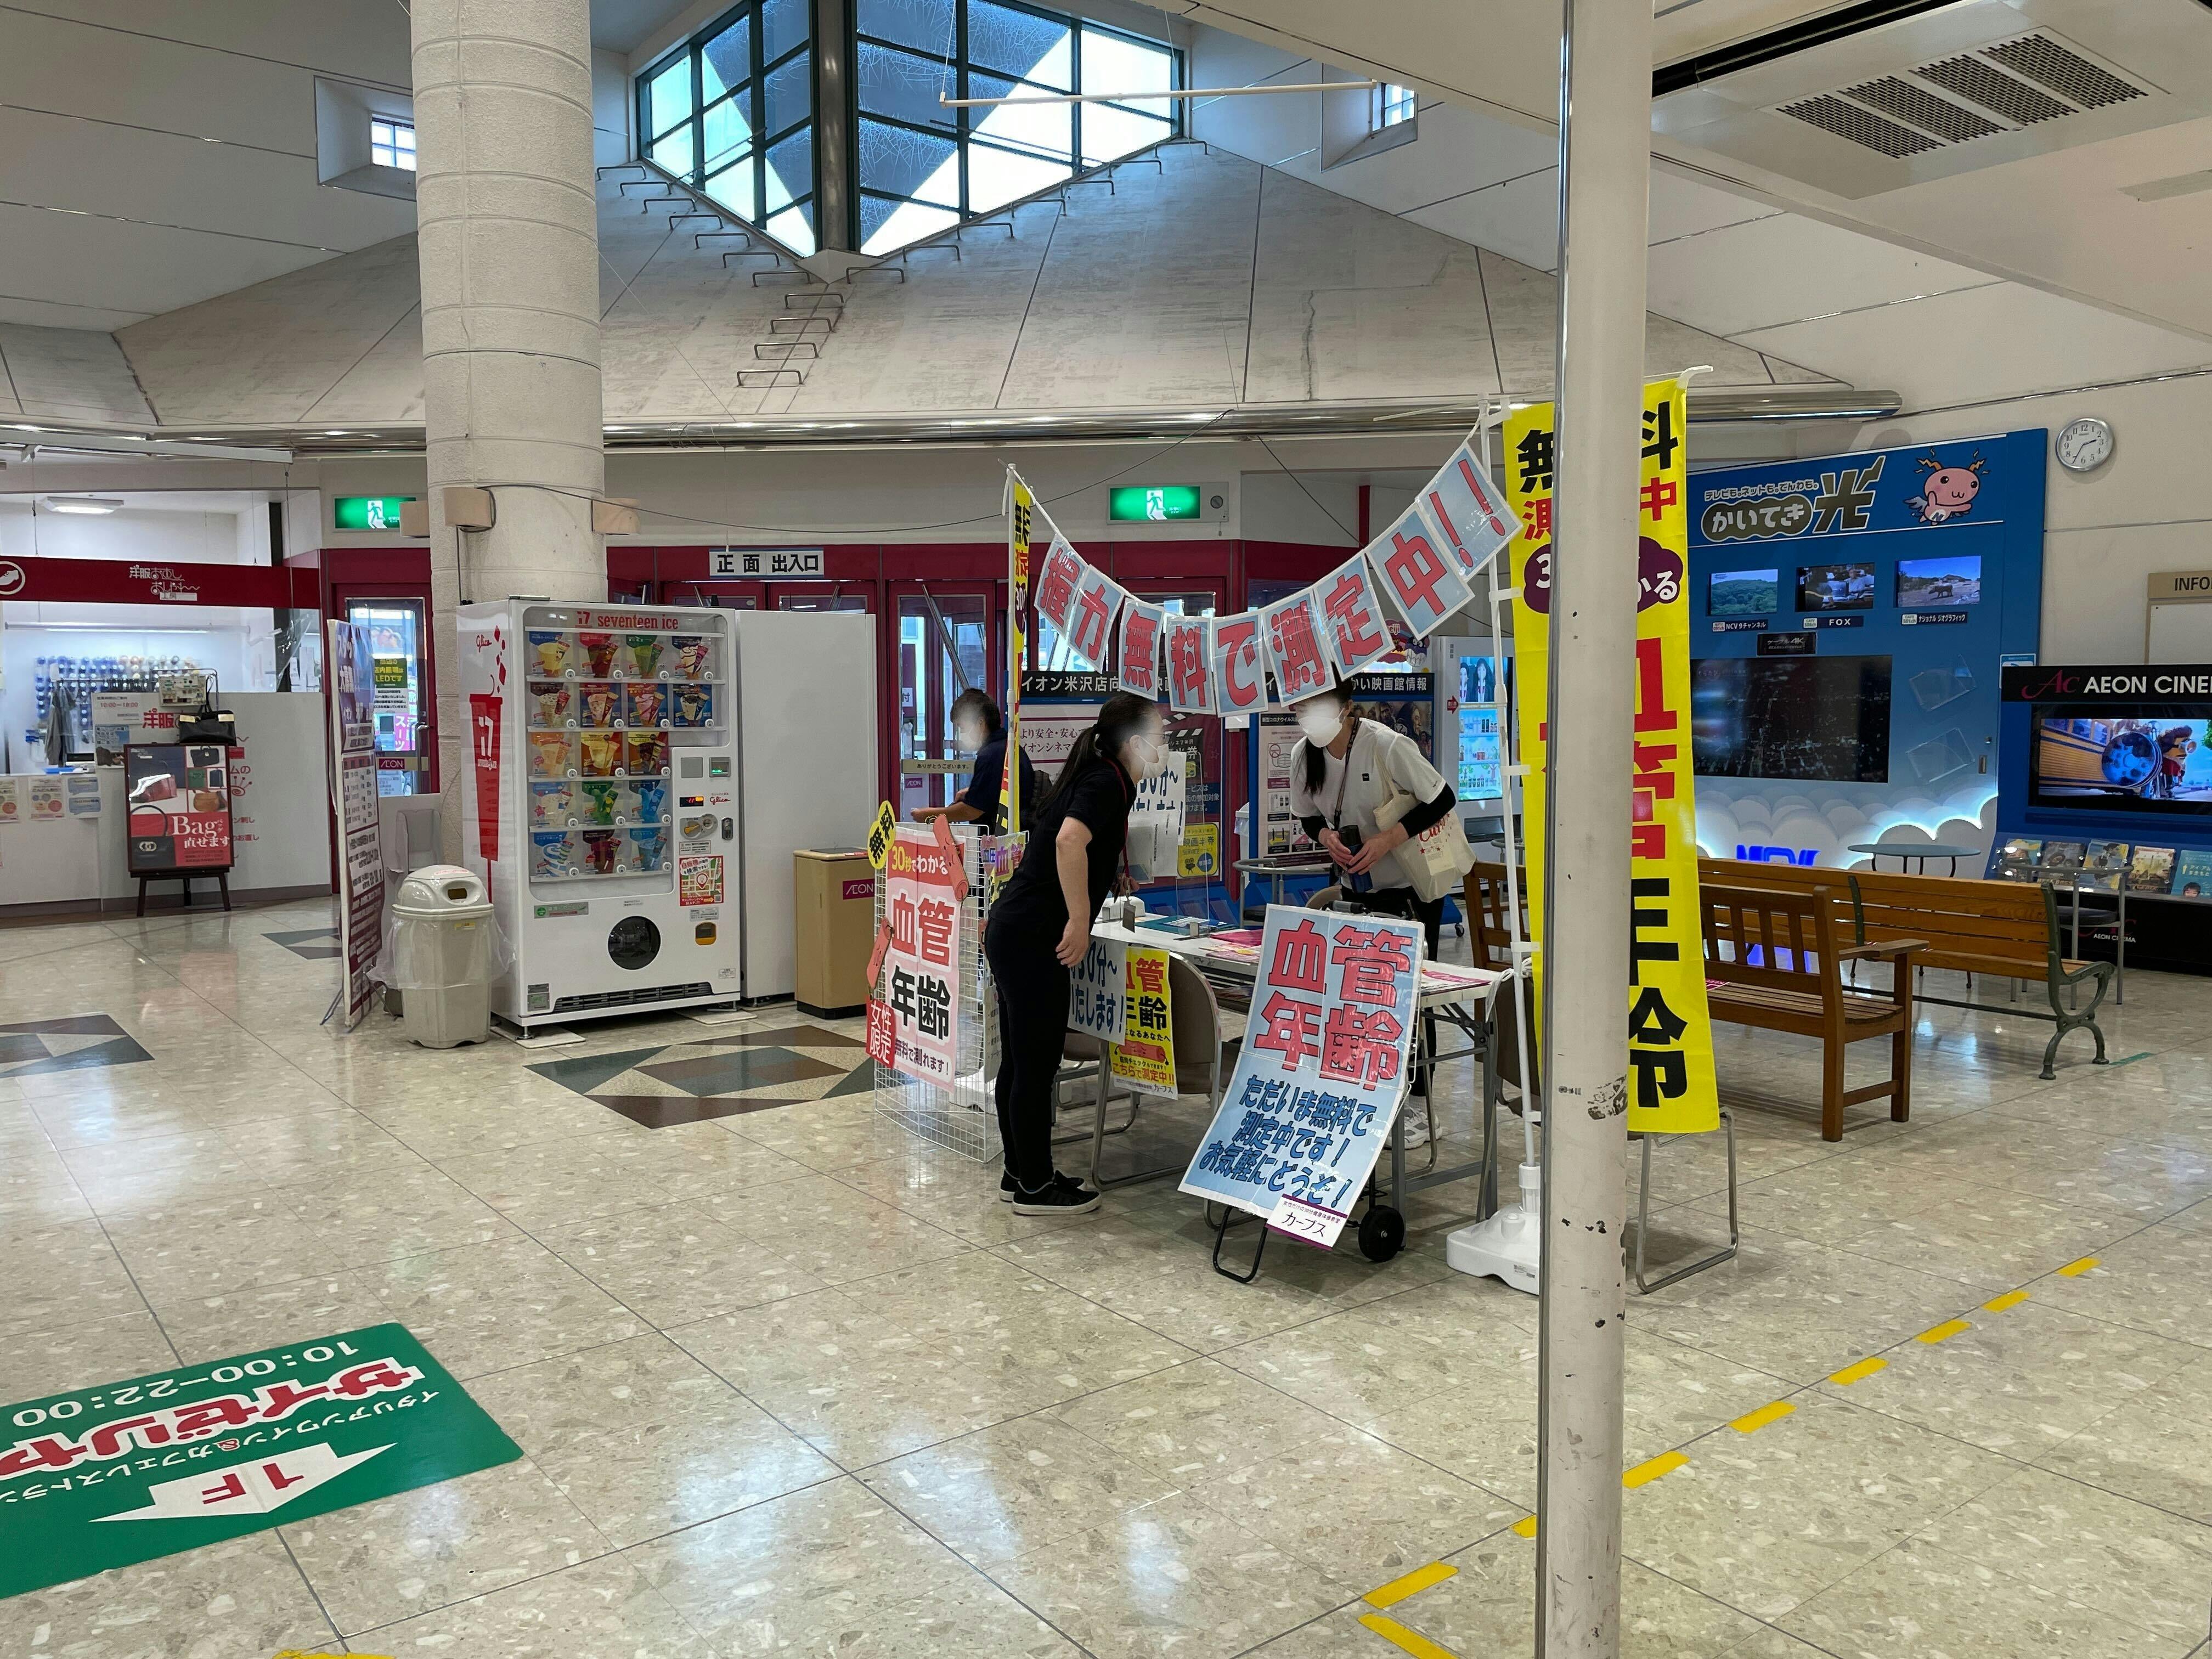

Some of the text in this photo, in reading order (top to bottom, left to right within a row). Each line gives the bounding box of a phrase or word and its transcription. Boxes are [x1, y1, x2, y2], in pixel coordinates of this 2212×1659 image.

[1812, 455, 1886, 534] 光
[1712, 503, 1804, 533] かいてき
[2175, 577, 2212, 591] INFO
[597, 615, 658, 629] seventeen
[662, 614, 679, 630] ice
[2083, 676, 2147, 693] AEON
[2154, 676, 2212, 693] CINE
[172, 815, 217, 838] Bag
[184, 836, 230, 849] 直せます
[891, 846, 949, 875] 30秒でわかる
[891, 892, 956, 967] 血管
[1267, 918, 1414, 1009] 血管
[870, 1002, 891, 1037] 女性
[890, 964, 951, 1040] 年齢
[870, 1030, 891, 1064] 限定
[895, 1037, 949, 1076] 無料で測れます！
[1254, 990, 1404, 1092] 年齢
[1239, 1074, 1378, 1137] ただいま無料で
[1232, 1110, 1351, 1167] 測定中です！
[0, 1356, 424, 1480] サイゼリヤ
[201, 1462, 305, 1505] 1F
